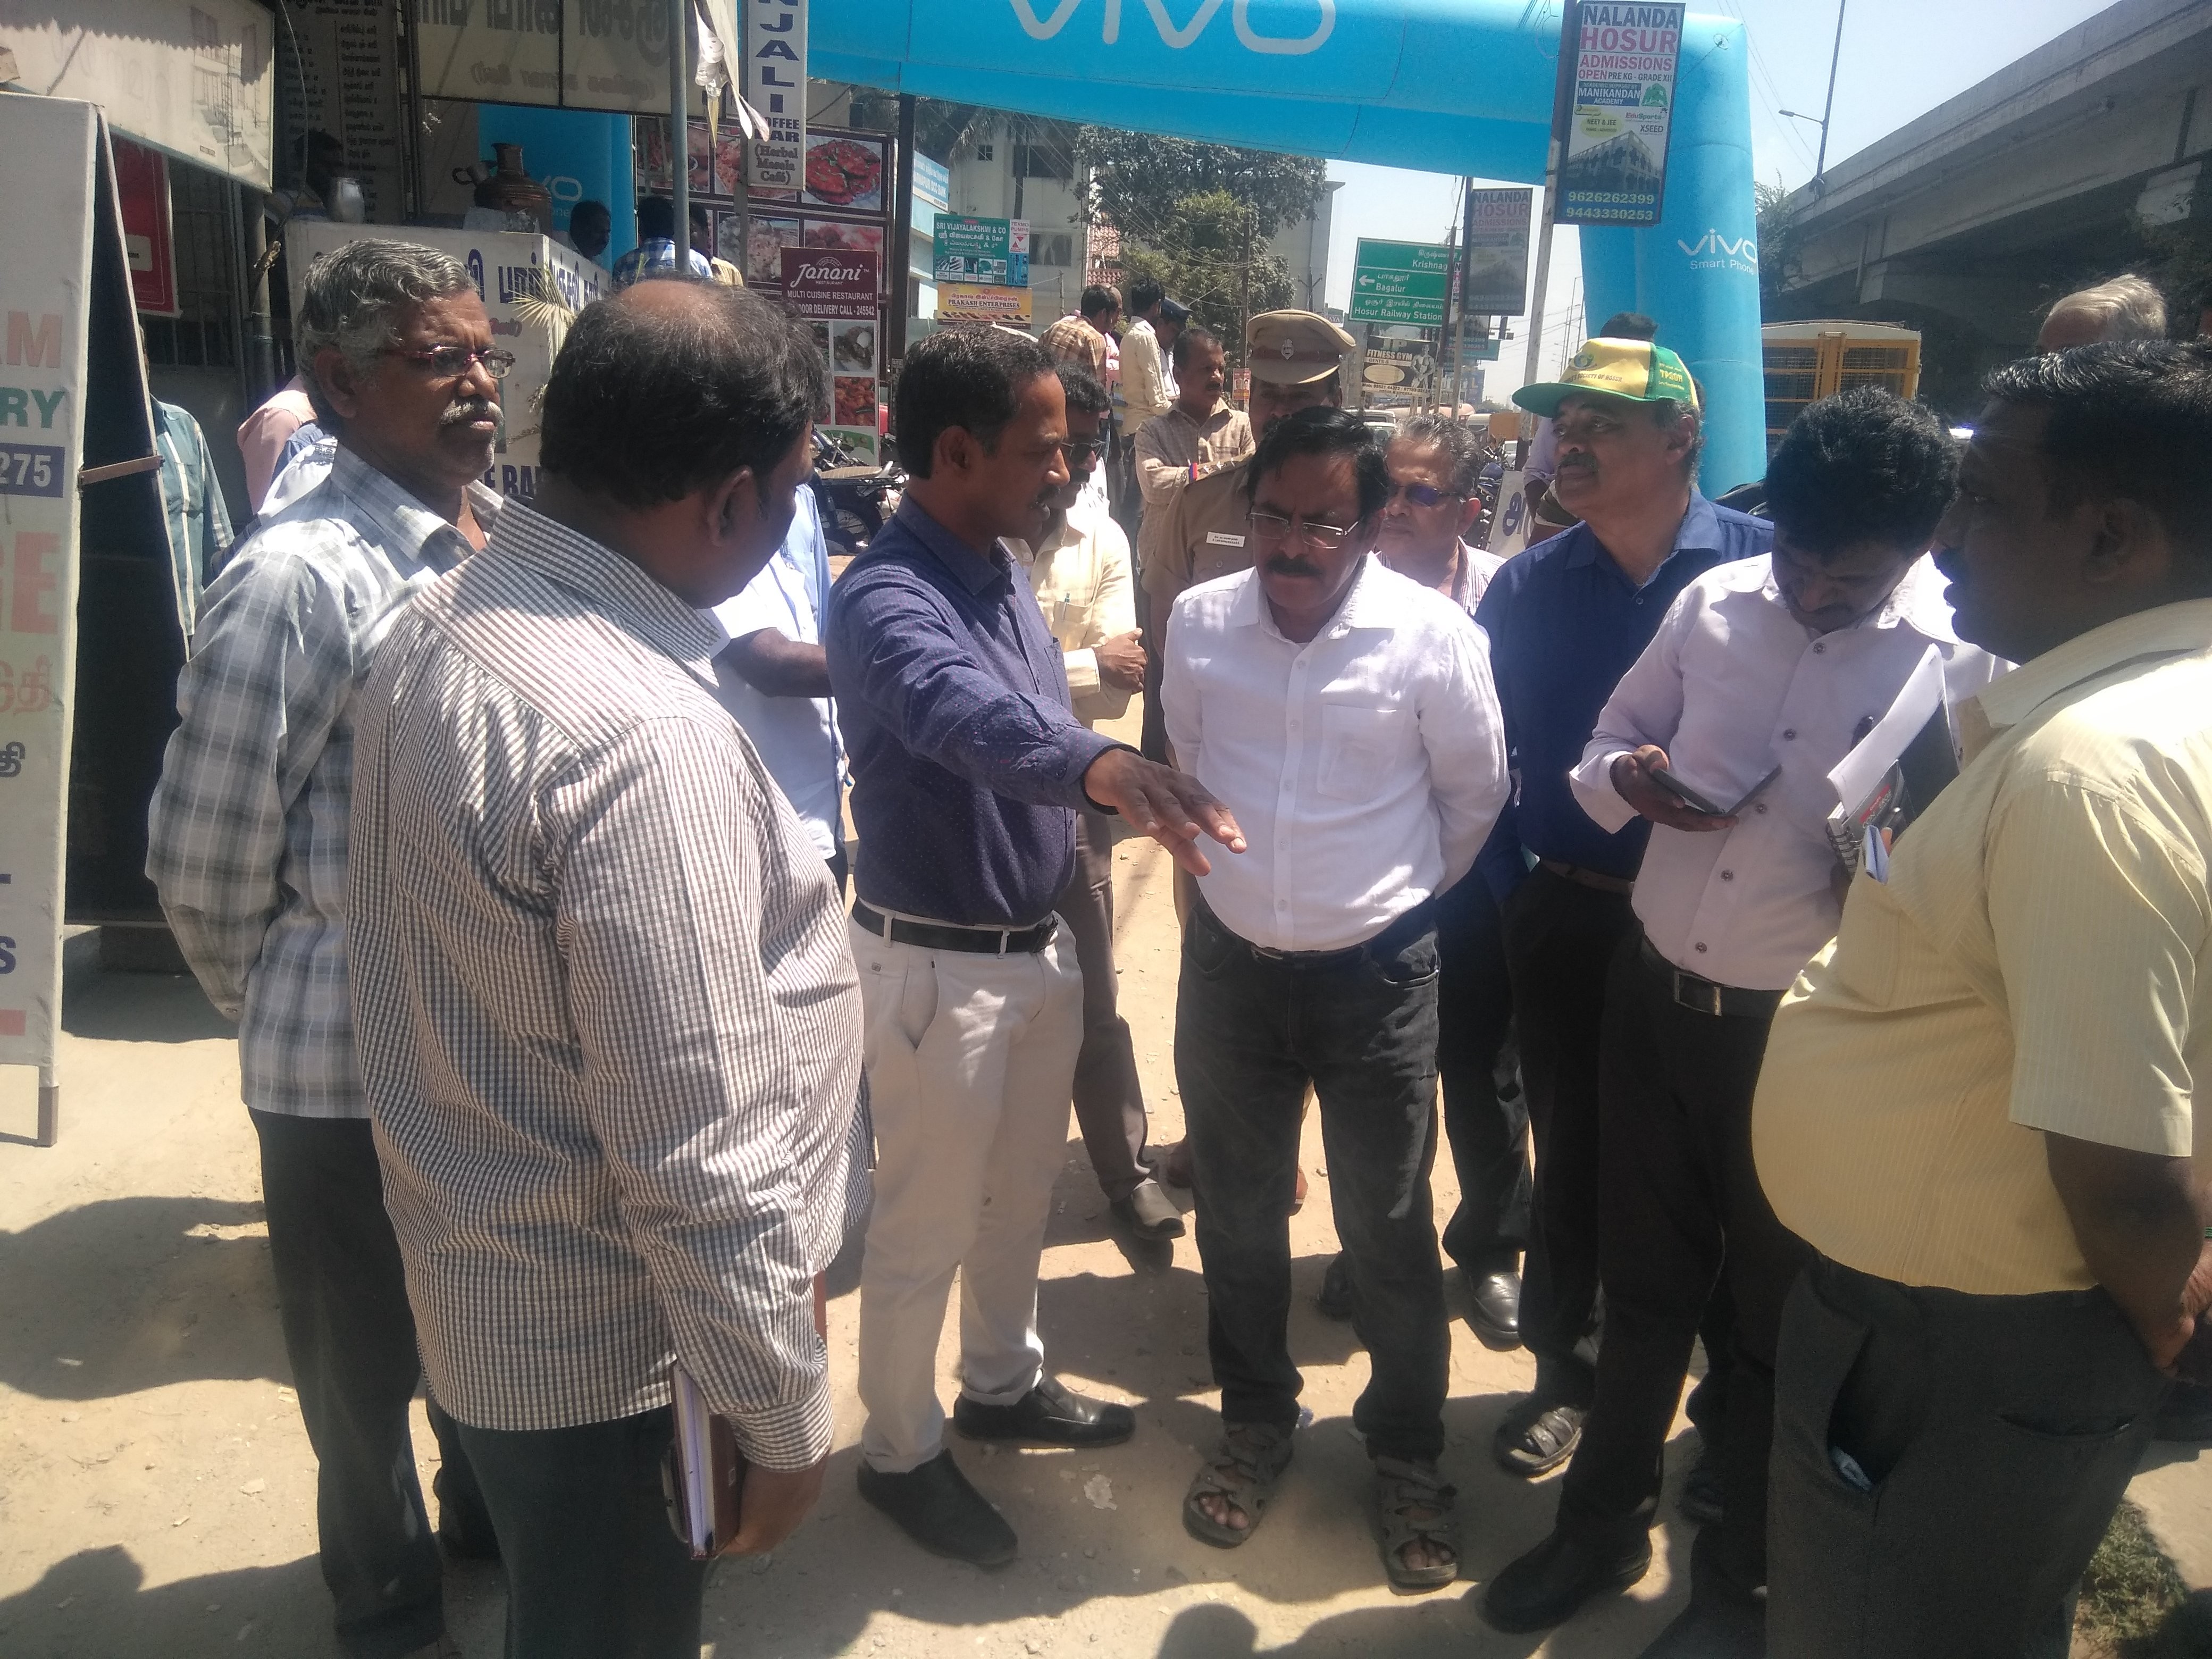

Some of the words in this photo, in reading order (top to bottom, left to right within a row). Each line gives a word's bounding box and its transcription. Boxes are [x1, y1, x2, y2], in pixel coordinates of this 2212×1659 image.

[1584, 6, 1678, 28] NALANDA
[1580, 28, 1677, 53] HOSUR
[756, 0, 800, 113] JALI
[1580, 54, 1673, 71] ADMISSIONS
[1578, 69, 1607, 80] OPEN
[1578, 88, 1641, 99] MANIKANDAN
[754, 117, 800, 129] OFFEE
[1640, 124, 1664, 133] XSEED
[1472, 191, 1529, 204] NALANDA
[1569, 191, 1654, 205] 9626262399
[1566, 207, 1653, 221] 9443330253
[947, 223, 991, 233] VIJAYALAKSHMI
[1678, 228, 1757, 264] vivo
[1412, 259, 1448, 271] Krishnag
[1690, 259, 1725, 270] Smart
[790, 264, 864, 288] Janani
[1376, 283, 1406, 293] Bagalur
[807, 291, 831, 299] CUISINE
[833, 292, 873, 301] RESTAURANT
[814, 305, 839, 315] DELIVERY
[840, 306, 852, 315] CALL
[857, 306, 875, 316] 245542
[1354, 307, 1378, 316] Hosur
[1381, 307, 1411, 319] Railway
[1413, 311, 1443, 321] Station
[0, 311, 63, 368] M
[1367, 349, 1395, 359] FITNESS
[1396, 352, 1413, 361] GYM
[502, 465, 543, 498] BA
[0, 532, 61, 634] E
